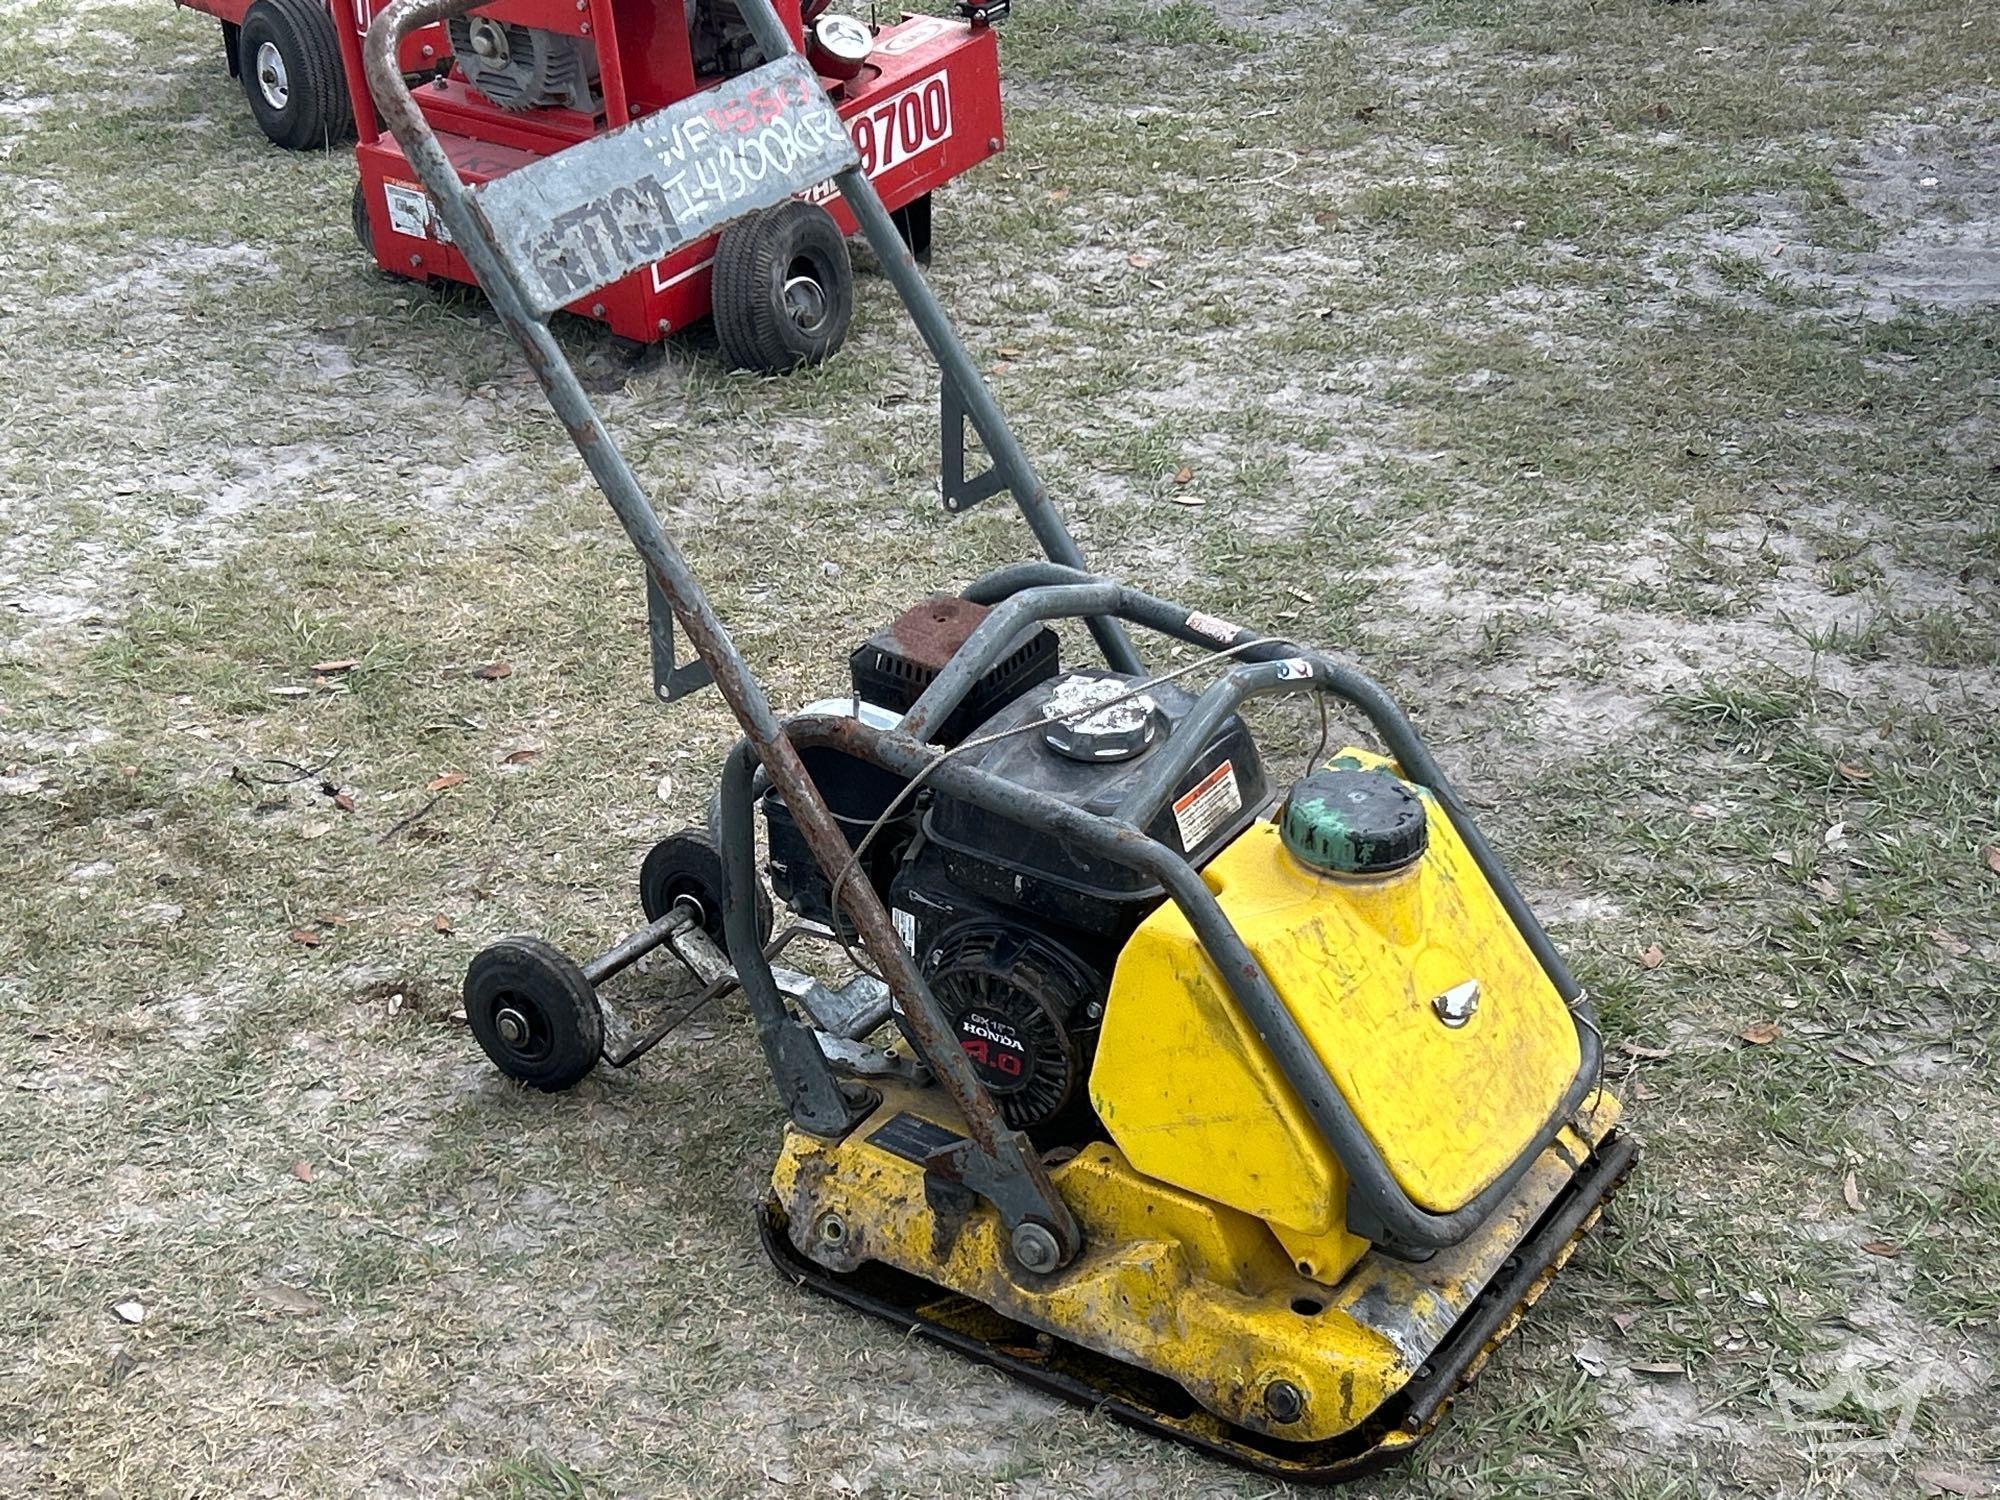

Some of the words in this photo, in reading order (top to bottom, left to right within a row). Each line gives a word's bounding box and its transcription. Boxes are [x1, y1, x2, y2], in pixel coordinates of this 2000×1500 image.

[852, 80, 947, 177] 9700
[963, 1021, 1025, 1051] HONDA
[960, 1040, 1022, 1076] 4.0
